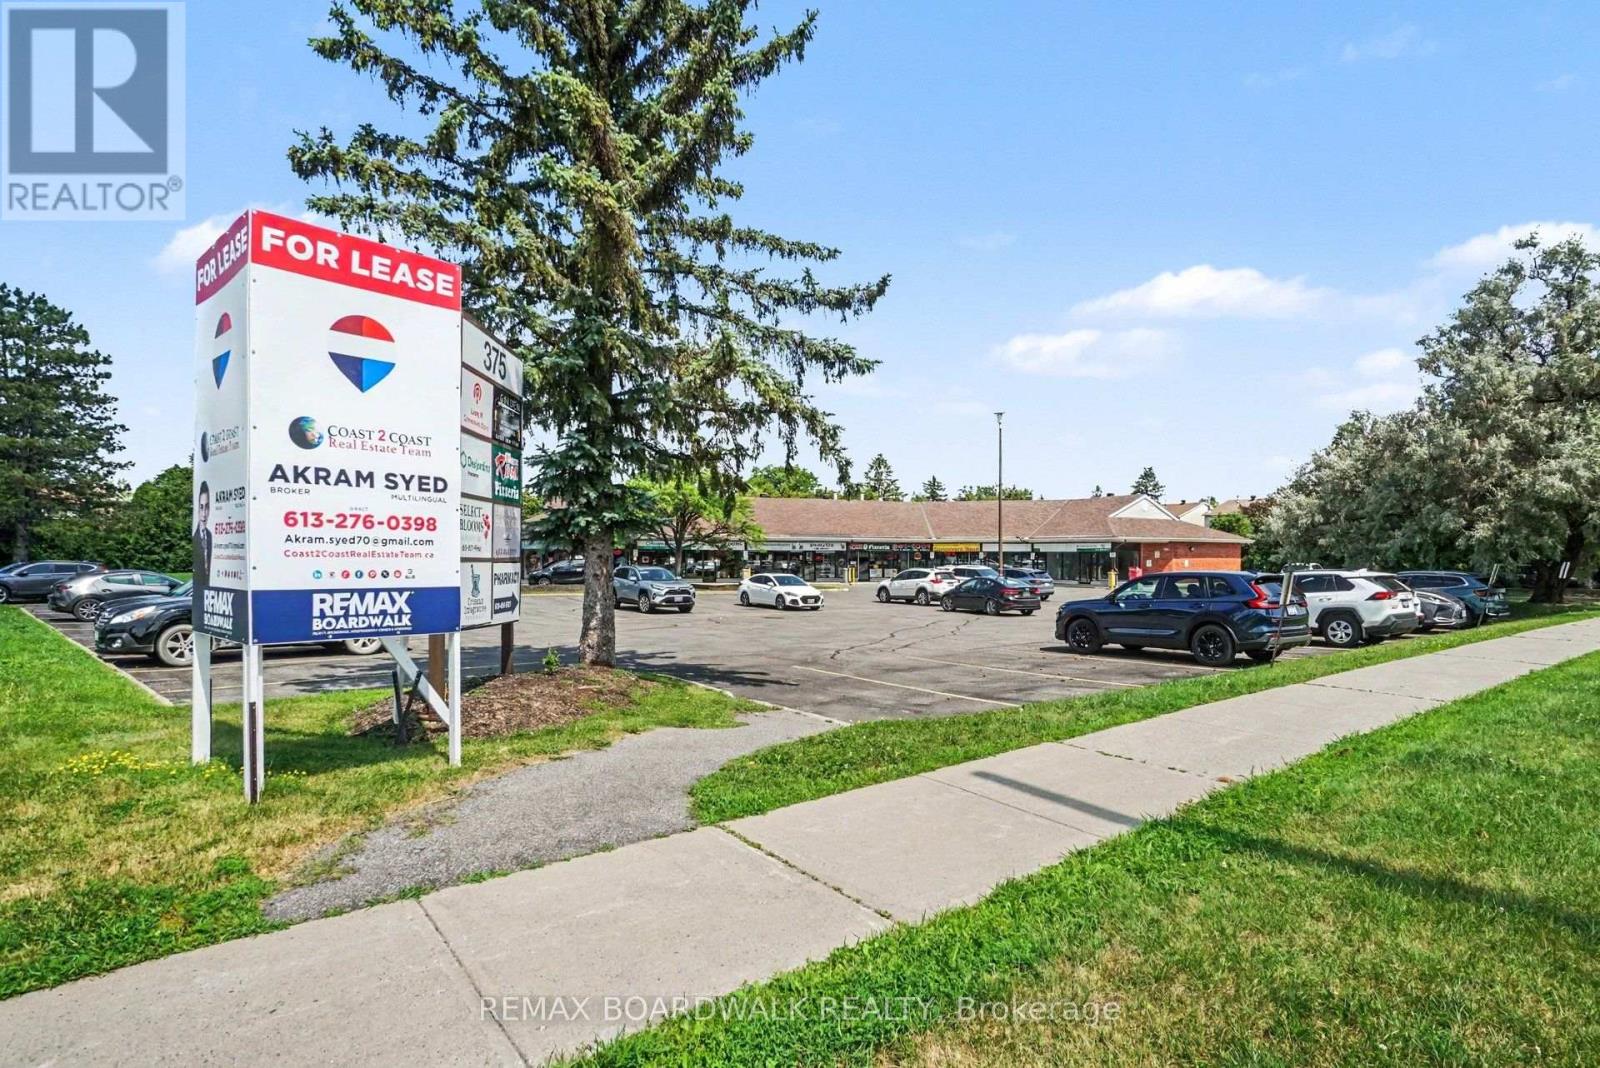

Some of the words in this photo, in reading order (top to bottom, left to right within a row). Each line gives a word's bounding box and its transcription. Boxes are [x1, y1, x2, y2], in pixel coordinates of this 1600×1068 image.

[197, 255, 217, 292] FOR
[217, 226, 248, 277] LEASE
[261, 225, 340, 270] FOR
[351, 250, 455, 297] LEASE
[483, 341, 507, 380] 375
[327, 424, 375, 440] COAST
[378, 429, 386, 441] 2
[389, 432, 432, 447] COAST
[328, 436, 357, 449] Real
[361, 440, 397, 454] Estate
[400, 444, 432, 457] Team
[269, 463, 375, 489] AKRAM
[384, 473, 449, 494] SYED
[270, 486, 311, 495] BROKER
[391, 494, 447, 504] MULTILINGUAL
[284, 511, 438, 532] 613-276-0398
[460, 503, 483, 518] SELECT
[284, 534, 435, 547] Akram.syed70@gmail.com
[204, 589, 235, 617] REMAX
[312, 591, 412, 617] REMAX
[312, 614, 413, 631] BOARDWALK
